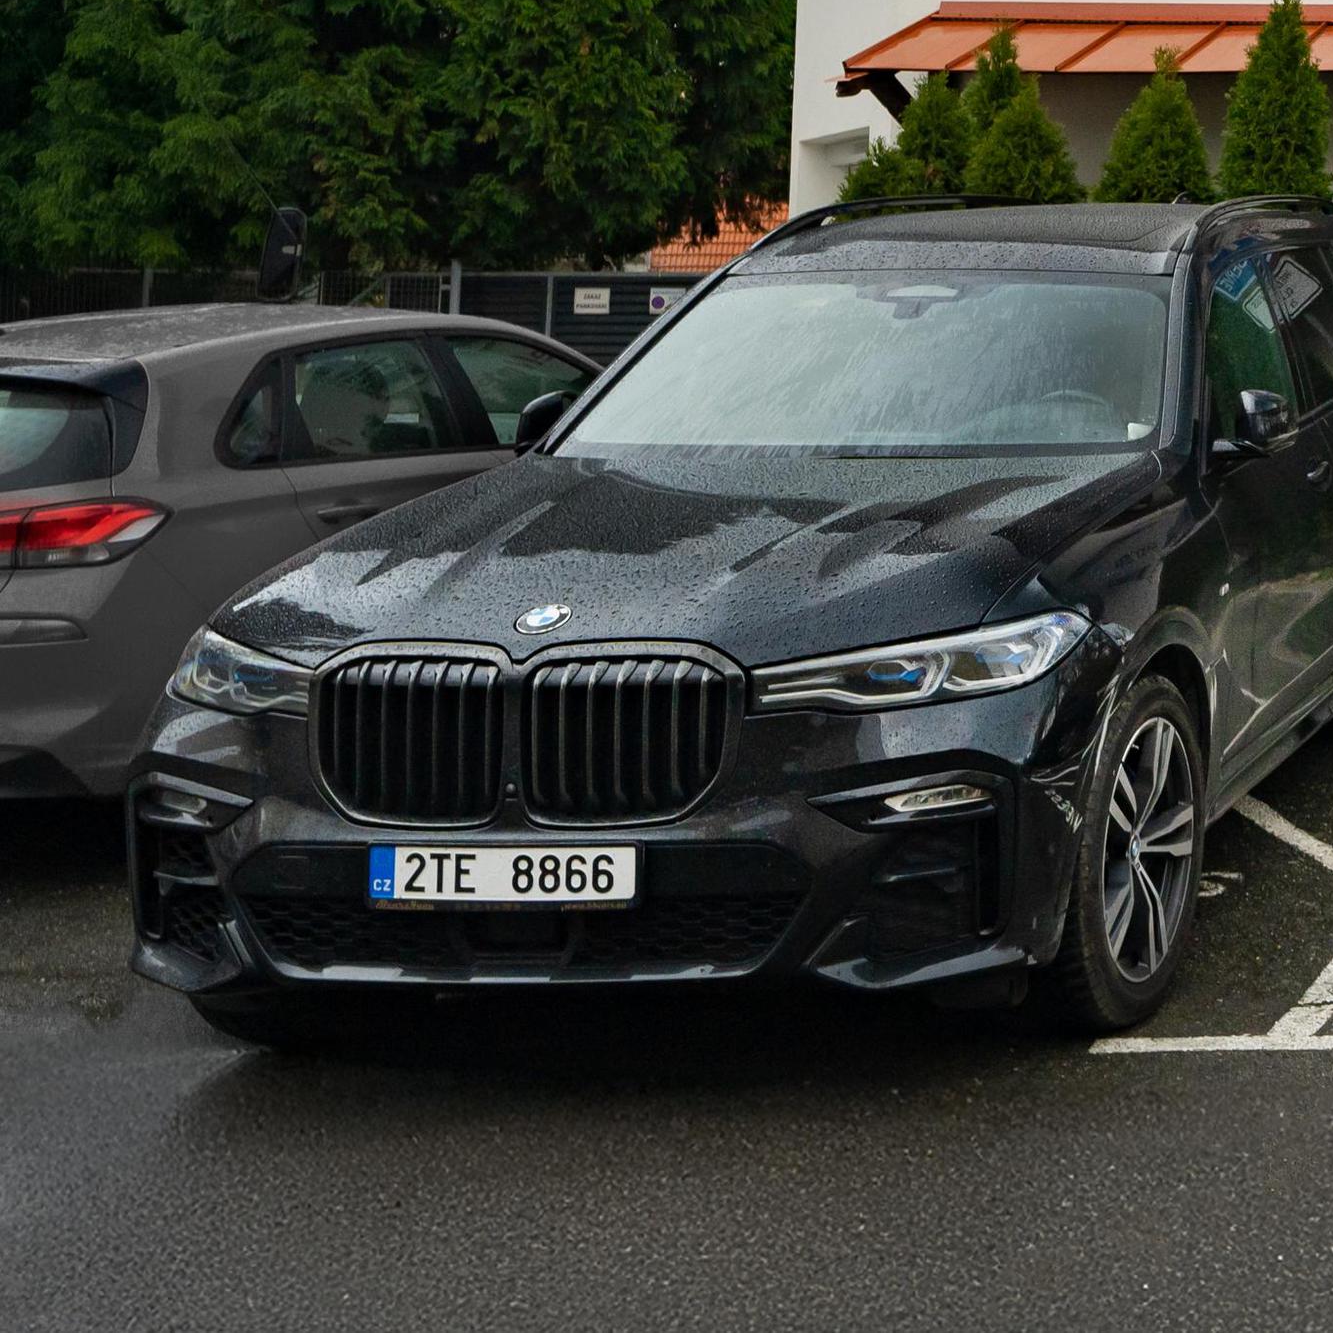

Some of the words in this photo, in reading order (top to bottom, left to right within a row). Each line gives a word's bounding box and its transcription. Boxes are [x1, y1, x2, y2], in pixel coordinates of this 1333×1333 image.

[373, 878, 392, 892] CZ
[404, 853, 477, 894] 2TE
[511, 854, 615, 894] 8866
